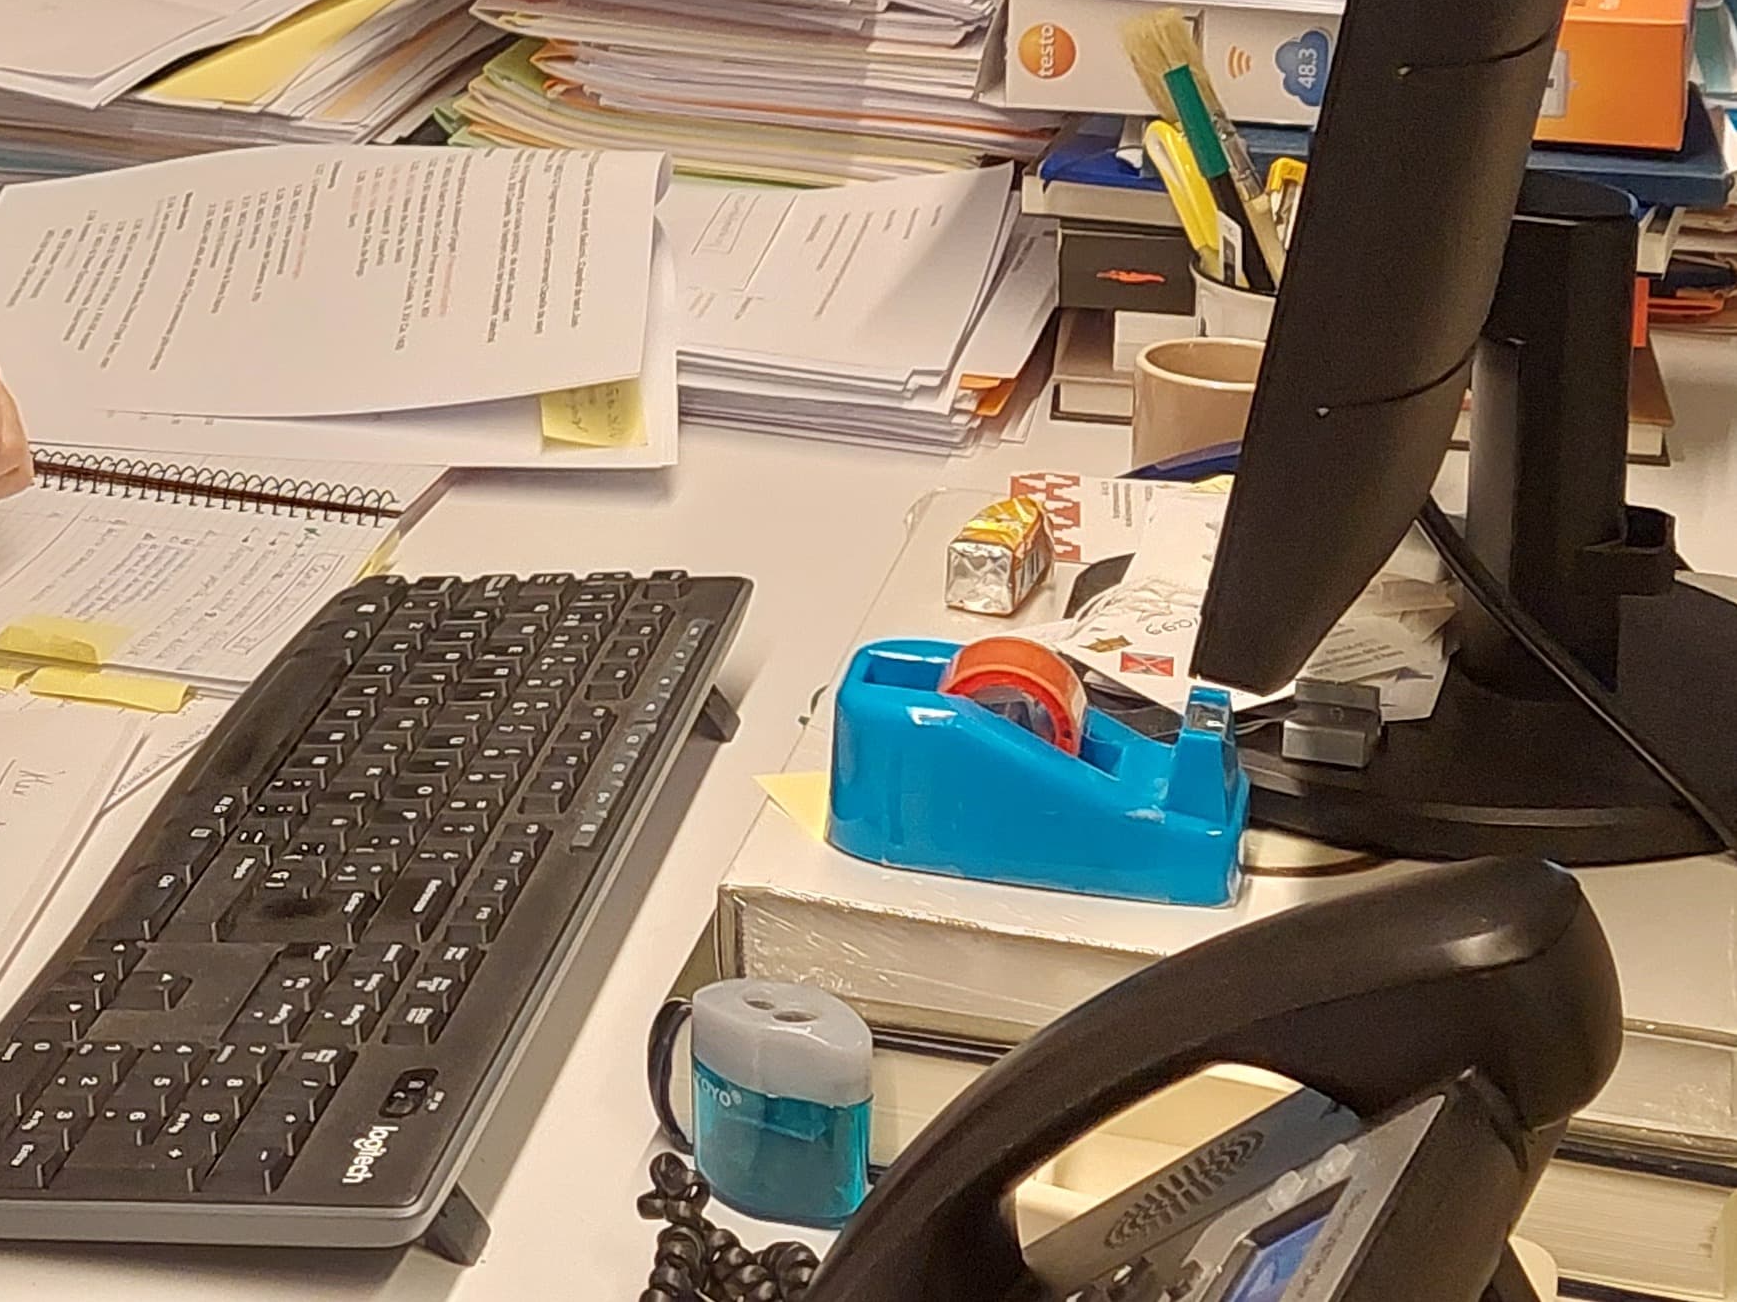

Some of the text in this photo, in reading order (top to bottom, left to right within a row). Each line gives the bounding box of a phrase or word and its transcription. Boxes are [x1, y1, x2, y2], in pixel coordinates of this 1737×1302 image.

[1037, 26, 1055, 78] testo
[1297, 47, 1319, 90] 48.3
[34, 1042, 50, 1051] 0
[176, 1045, 192, 1053] 4
[249, 1046, 266, 1054] 7
[80, 1077, 98, 1086] 2
[153, 1077, 171, 1086] 5
[226, 1078, 243, 1087] 8
[56, 1110, 73, 1119] 3
[129, 1111, 146, 1121] 6
[203, 1113, 221, 1122] 9
[343, 1126, 398, 1182] logitech
